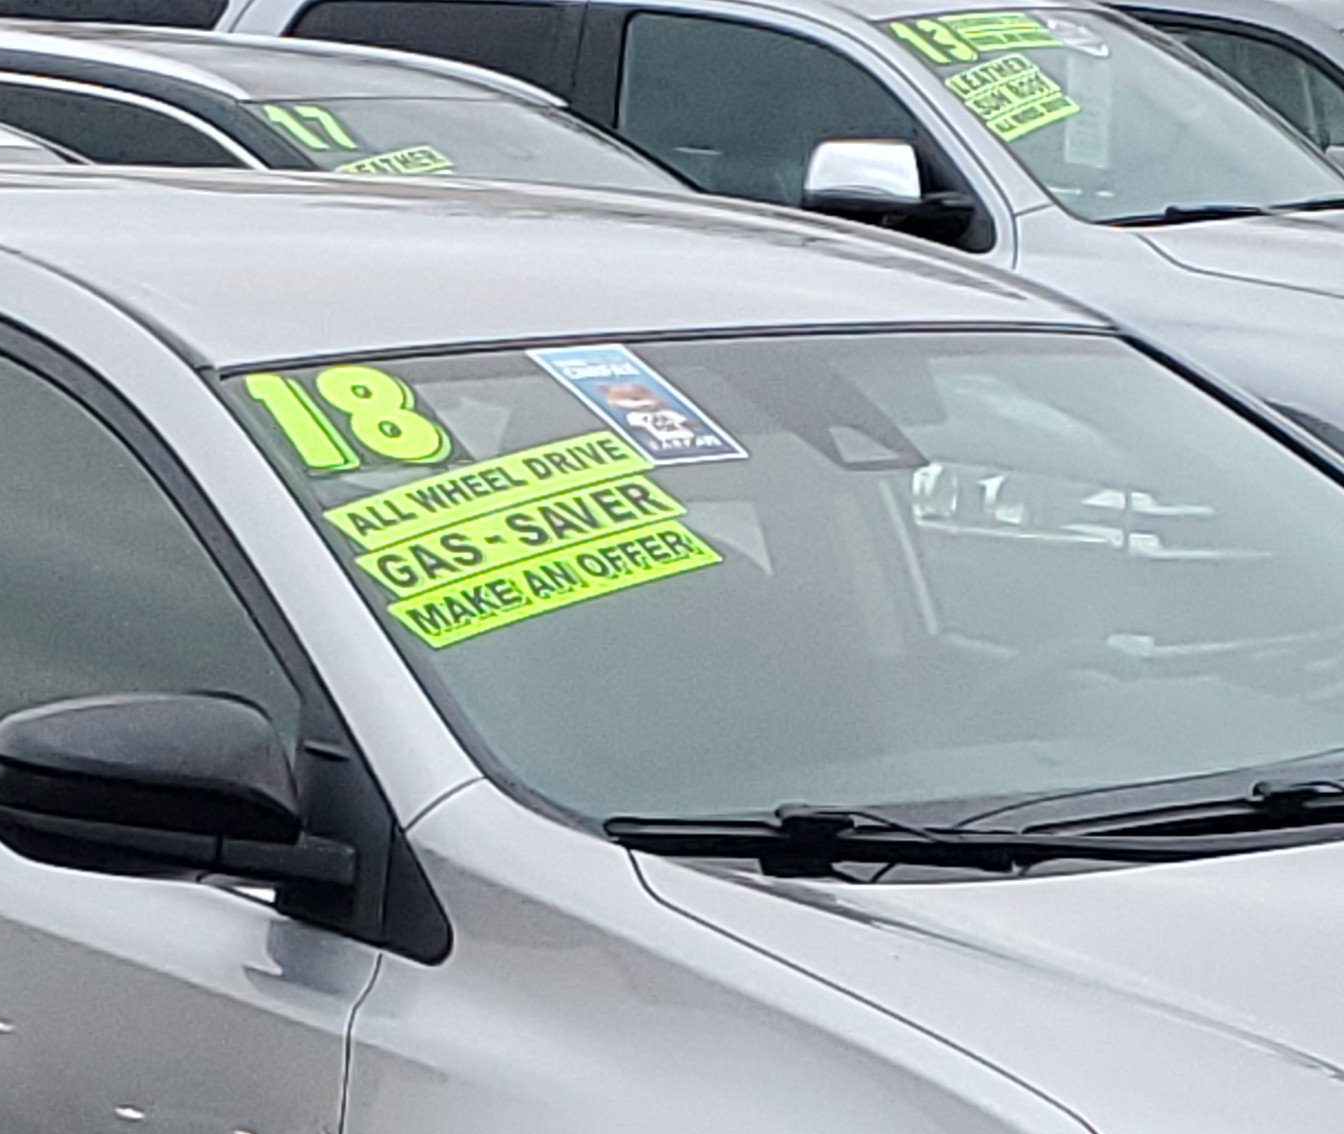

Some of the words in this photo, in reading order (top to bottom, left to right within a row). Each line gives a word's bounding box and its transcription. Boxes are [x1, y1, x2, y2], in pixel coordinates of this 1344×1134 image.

[890, 19, 978, 64] 13
[263, 105, 357, 150] 17
[245, 364, 454, 470] 18
[354, 500, 414, 537] ALL
[411, 464, 526, 513] WHEEL
[522, 437, 630, 480] DRIVE
[376, 531, 484, 589] GAS
[505, 483, 671, 548] SAVER
[406, 579, 522, 636] MAKE
[524, 560, 577, 600] AN
[580, 530, 696, 580] OFFER
